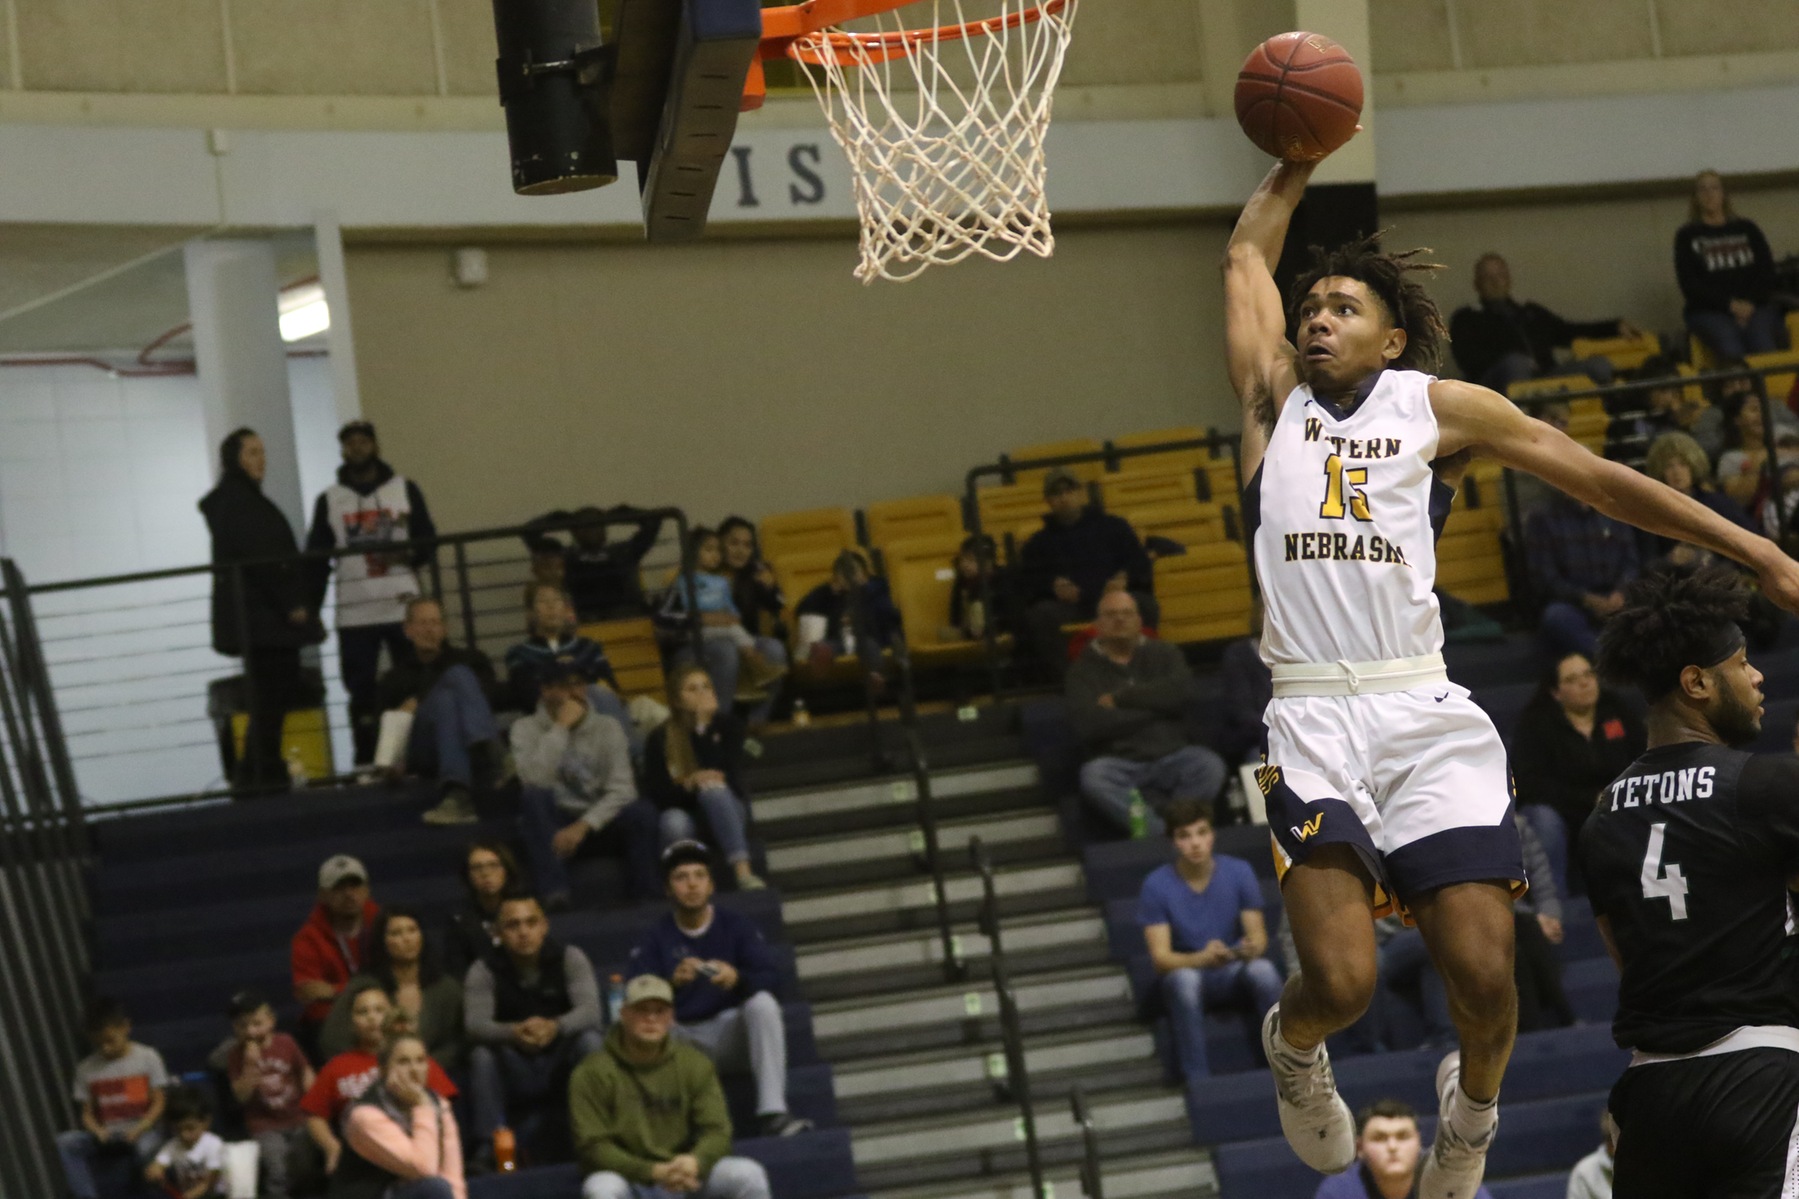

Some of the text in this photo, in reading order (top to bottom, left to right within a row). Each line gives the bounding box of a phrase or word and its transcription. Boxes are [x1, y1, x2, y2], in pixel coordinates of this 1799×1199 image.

[1304, 417, 1402, 459] WTERN
[1319, 453, 1374, 522] 15
[1611, 766, 1716, 812] TETONS
[1641, 823, 1689, 921] 4
